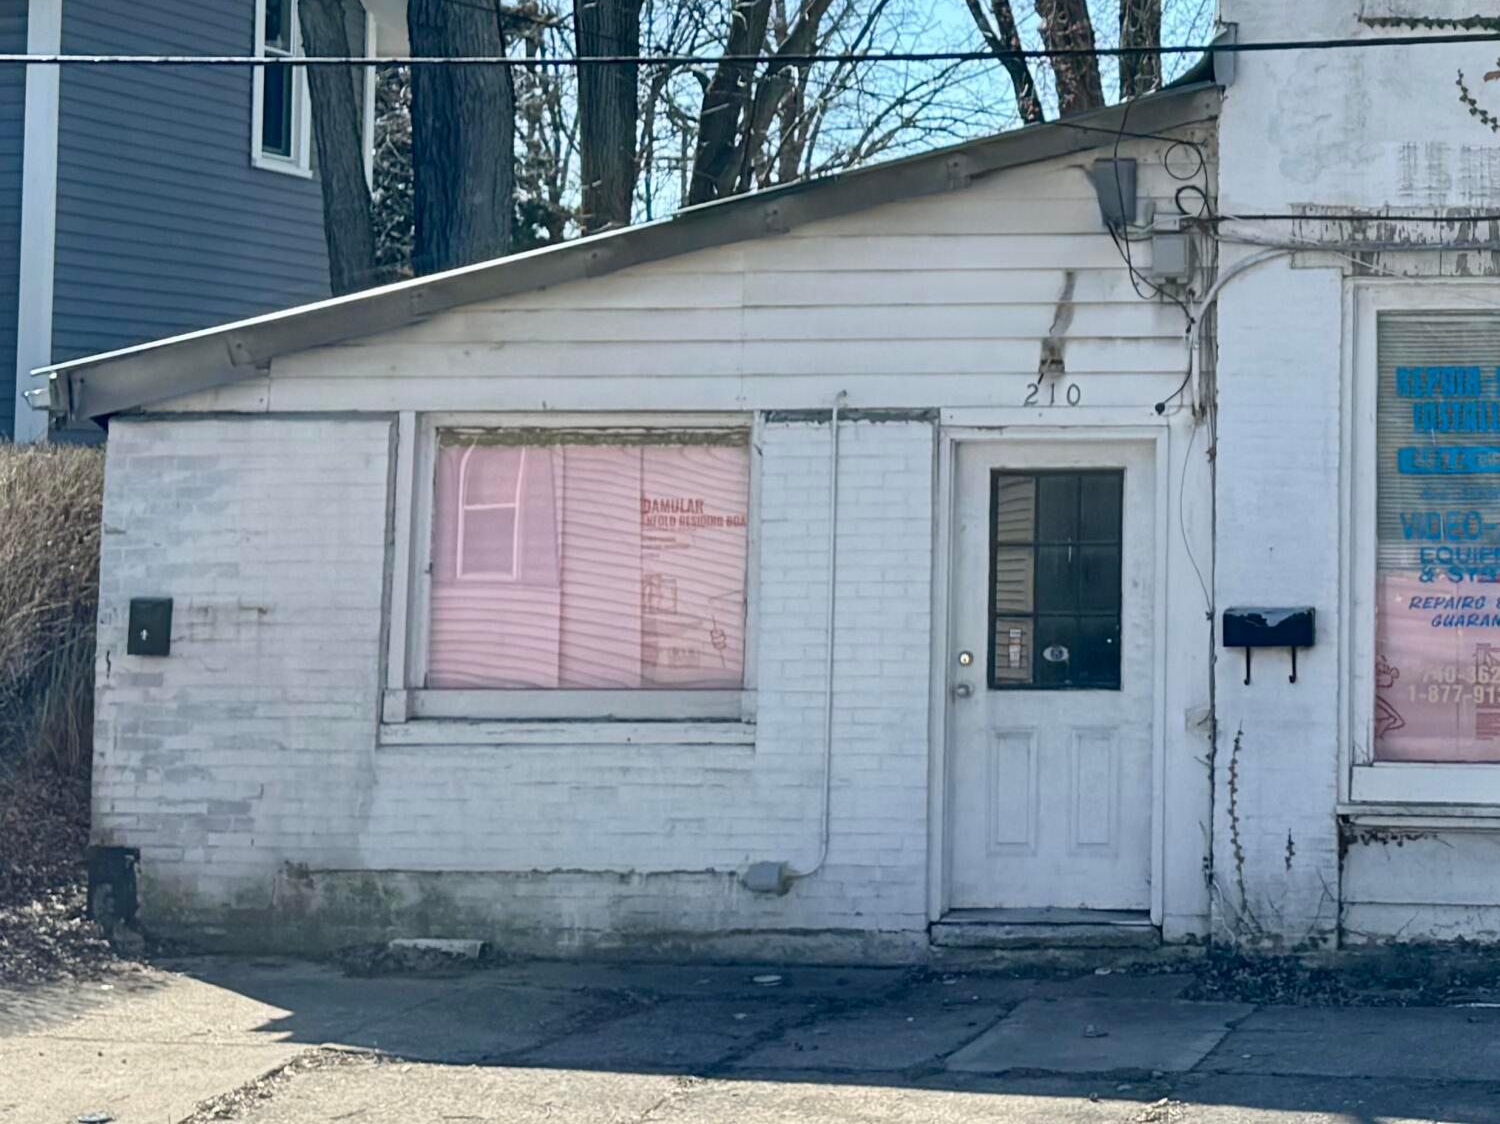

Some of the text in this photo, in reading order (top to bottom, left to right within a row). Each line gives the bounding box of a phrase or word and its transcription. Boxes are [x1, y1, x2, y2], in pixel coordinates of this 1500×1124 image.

[1023, 383, 1081, 408] 210
[1419, 567, 1434, 583] &
[1409, 596, 1485, 610] REPAIRS
